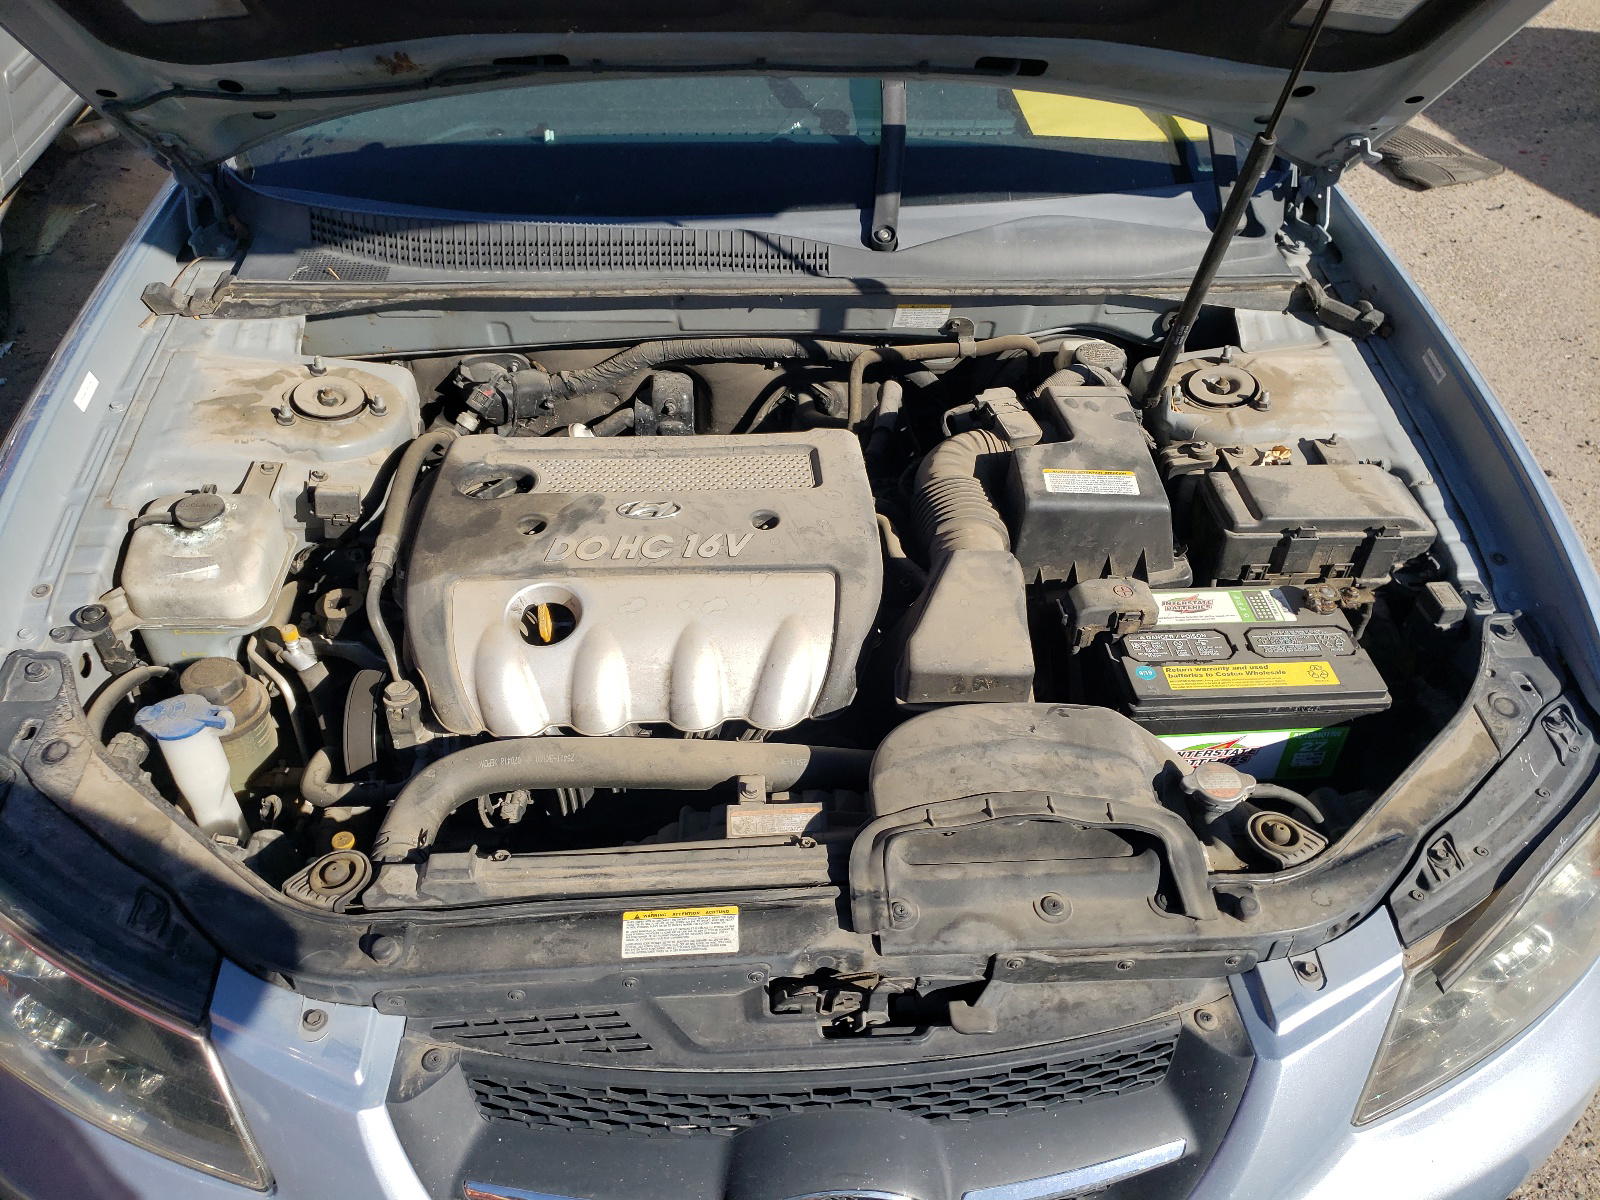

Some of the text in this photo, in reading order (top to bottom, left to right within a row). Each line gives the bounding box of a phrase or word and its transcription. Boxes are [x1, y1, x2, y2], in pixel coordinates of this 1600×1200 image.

[543, 532, 755, 562] DOHC 16V
[1165, 604, 1213, 612] BATTERIES
[1299, 741, 1327, 752] 27
[1177, 748, 1258, 757] NTERSTATE
